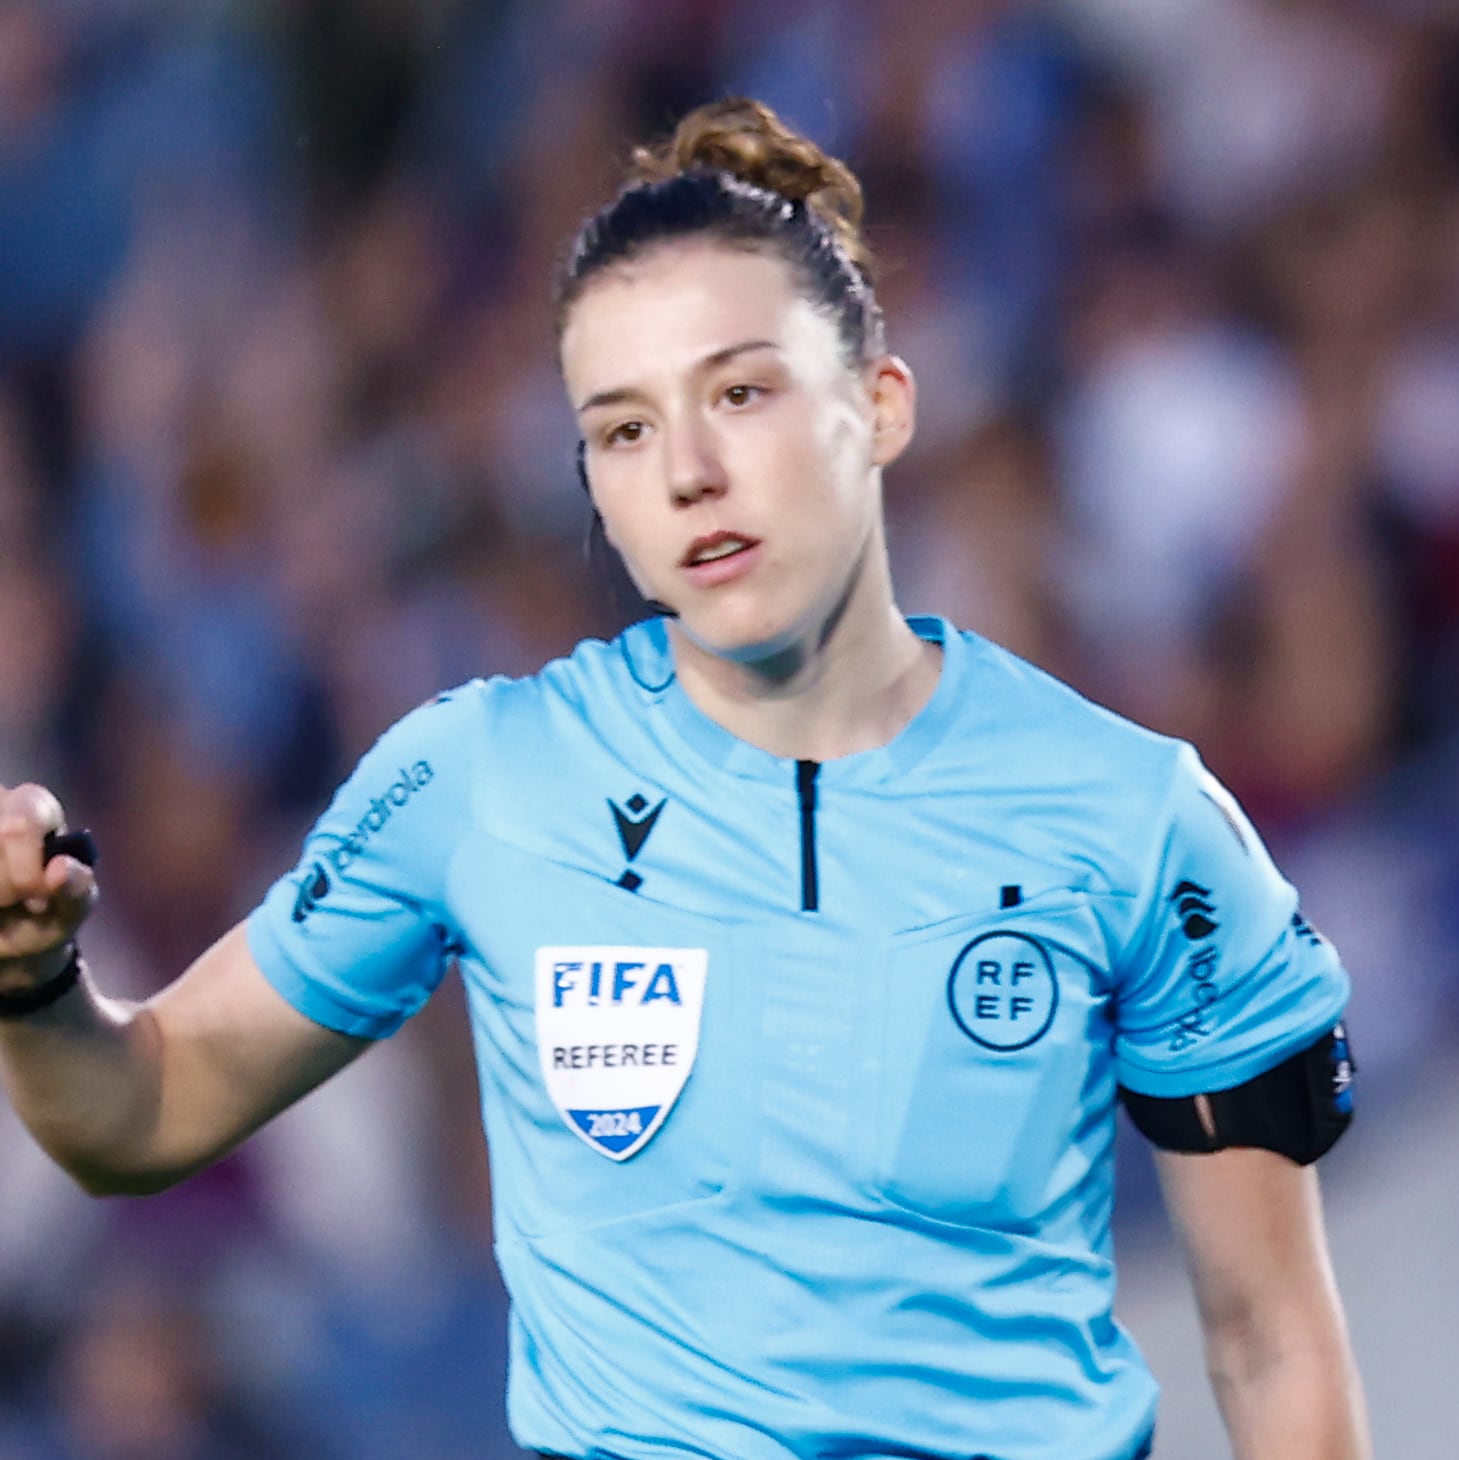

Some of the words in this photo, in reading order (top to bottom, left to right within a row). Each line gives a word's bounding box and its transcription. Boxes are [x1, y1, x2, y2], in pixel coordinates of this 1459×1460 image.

[552, 962, 682, 1007] FIFA
[552, 1044, 679, 1070] REFEREE
[586, 1112, 644, 1137] 2024
